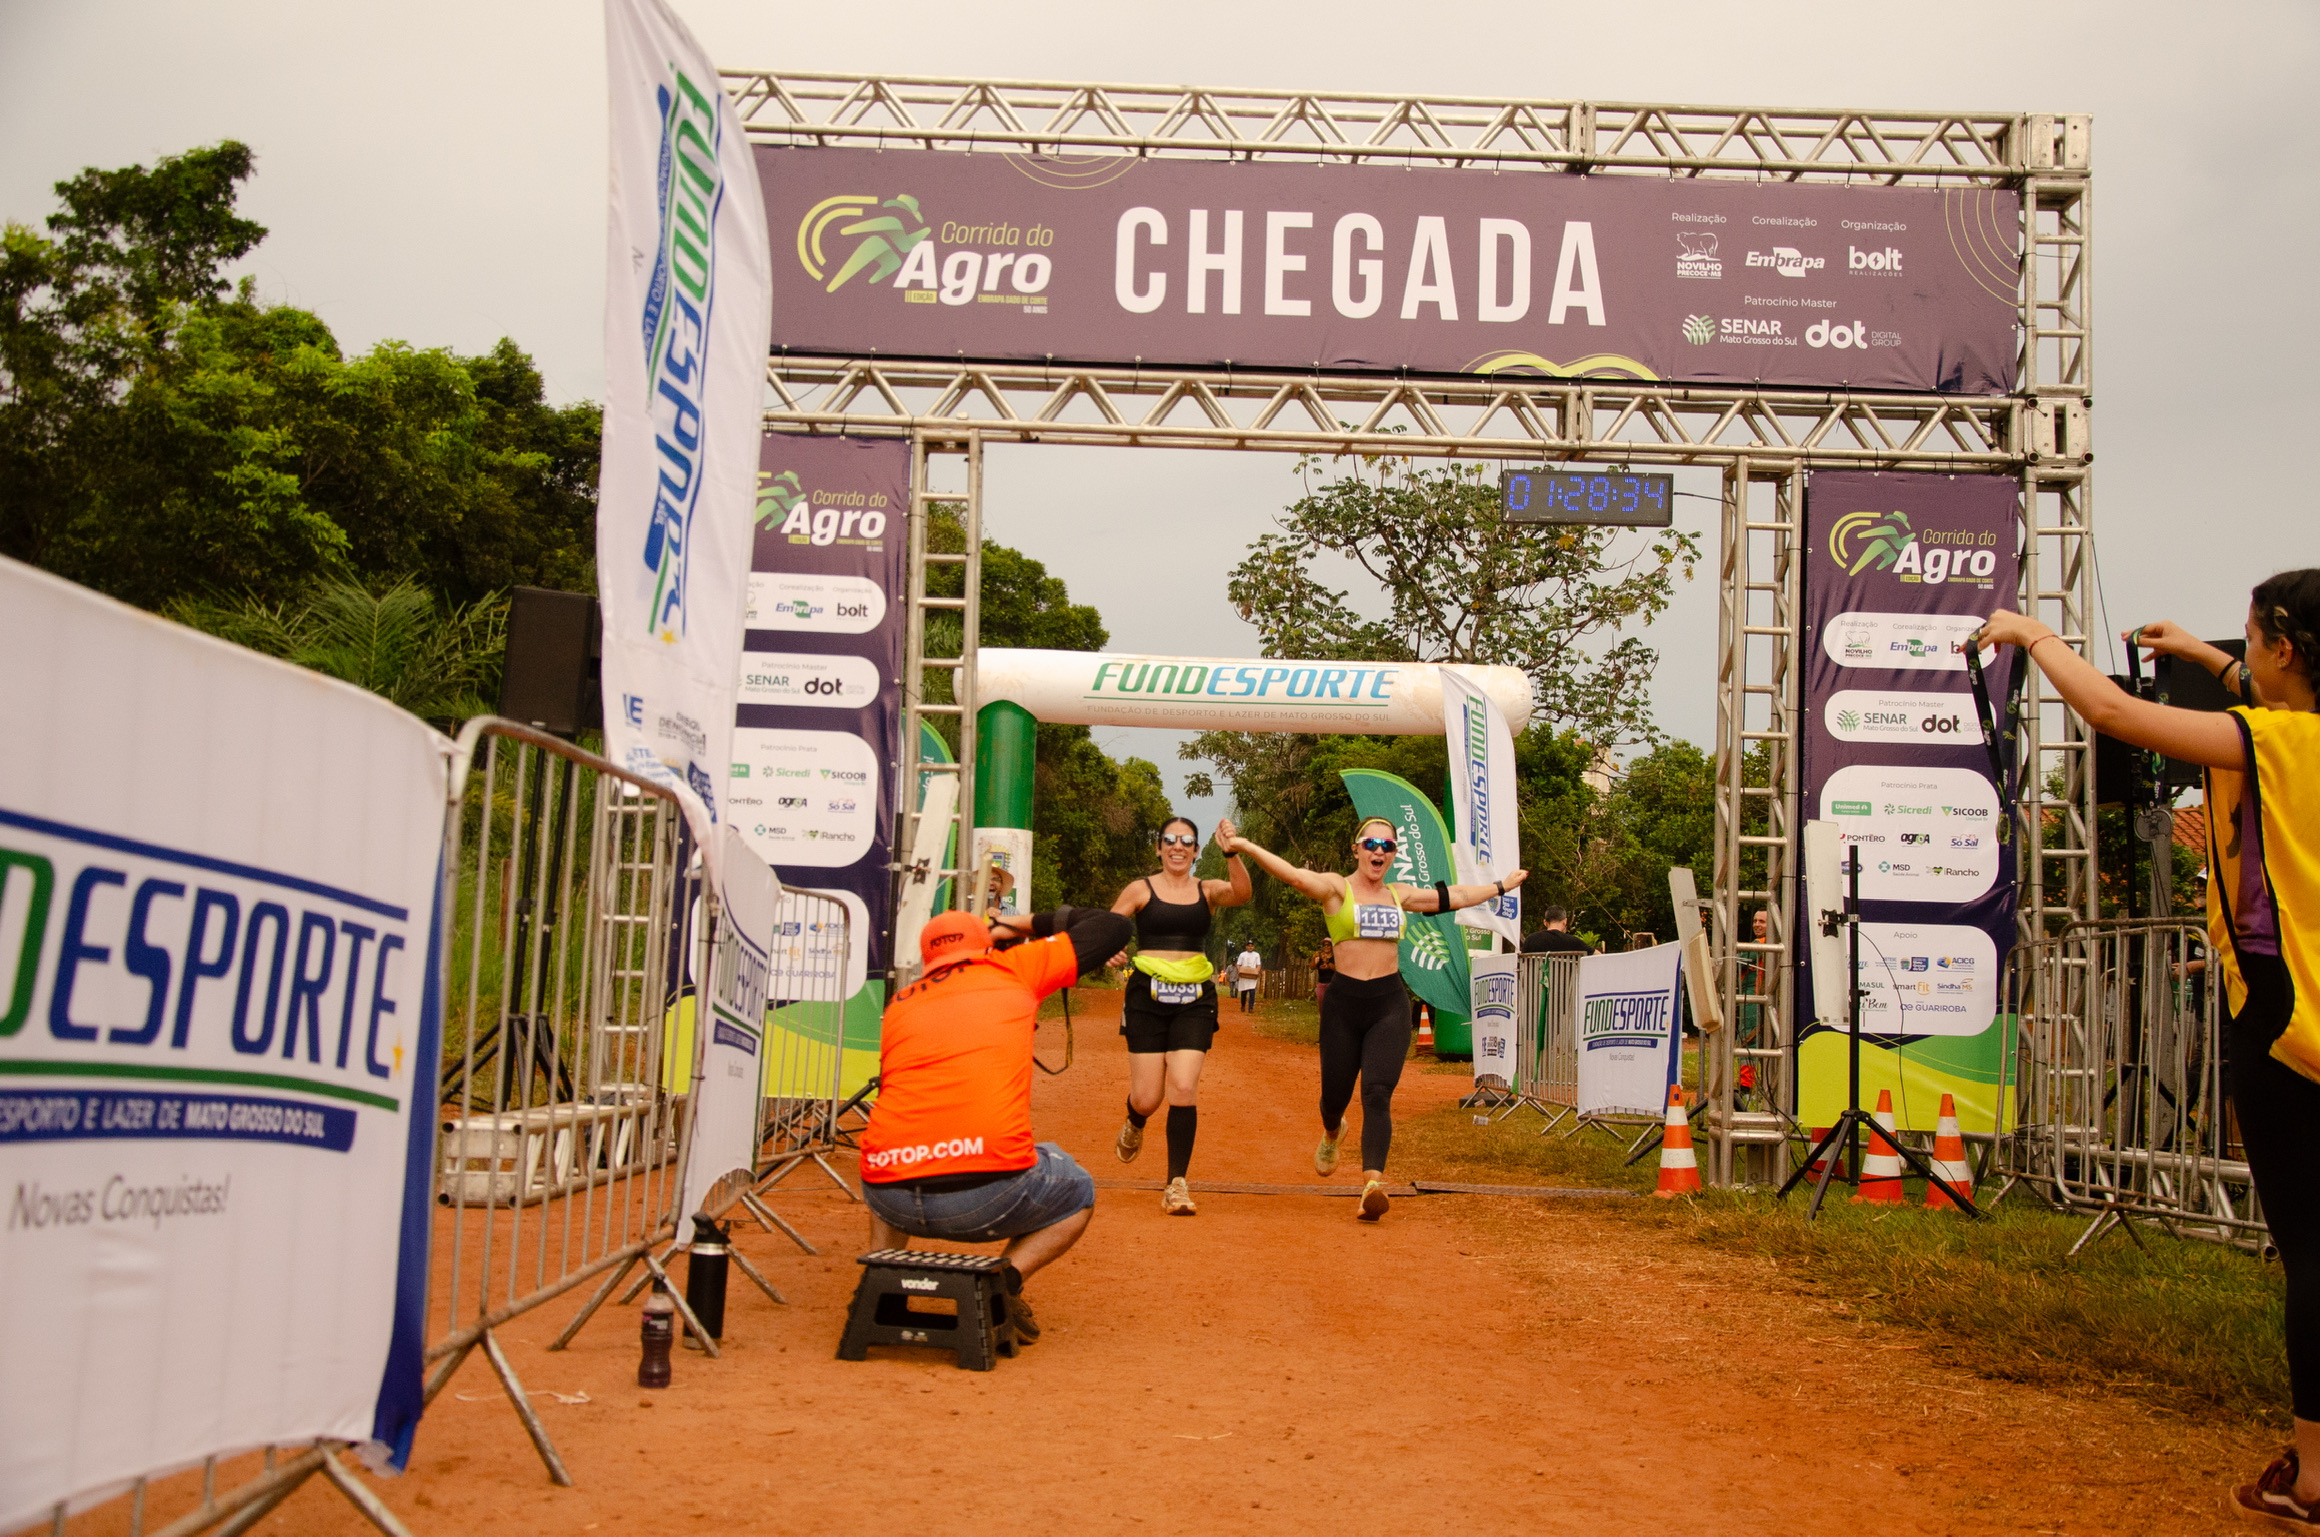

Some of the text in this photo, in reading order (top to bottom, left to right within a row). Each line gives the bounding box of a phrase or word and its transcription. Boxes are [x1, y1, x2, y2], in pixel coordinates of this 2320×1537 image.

[1671, 212, 1727, 225] Realização
[1752, 216, 1818, 228] Corealização
[1841, 219, 1907, 232] Organização
[941, 221, 1055, 248] Corrida do
[1745, 249, 1826, 272] Embrapa
[1849, 245, 1903, 271] bolt
[893, 239, 1053, 306] Agro
[1115, 206, 1606, 326] CHEGADA
[1676, 262, 1723, 271] NOVILHO
[1744, 295, 1837, 308] Patrocínio Master
[1720, 318, 1782, 335] SENAR
[1720, 335, 1798, 346] Mato Grosso do Sul
[1805, 319, 1869, 349] dot
[1871, 331, 1902, 340] DIGITAL
[1871, 339, 1902, 347] GROUP
[812, 489, 888, 508] Corrida do
[1508, 474, 1665, 512] 01:28:34
[780, 501, 887, 546] Agro
[1923, 528, 1996, 545] Corrida do
[1892, 541, 1996, 584] Agro
[778, 583, 824, 592] Corealização
[836, 602, 869, 618] bolt
[1840, 620, 1878, 629] Realização
[1892, 623, 1938, 632] Corealização
[1890, 640, 1938, 654] Embrapa
[761, 661, 828, 671] Patrocínio Master
[745, 674, 790, 686] SENAR
[804, 677, 843, 695] dot
[1091, 661, 1400, 700] FUNDESPORTE
[1878, 699, 1944, 709] Patrocínio Master
[1086, 705, 1141, 715] FUNDAÇÃO
[1162, 709, 1217, 717] DESPORTO
[1228, 710, 1260, 718] LAZER
[1263, 711, 1277, 719] DE
[1279, 712, 1308, 720] MATO
[1310, 712, 1352, 721] GROSSO
[1355, 713, 1370, 721] DO
[1373, 713, 1391, 722] SUL
[1864, 712, 1907, 724] SENAR
[1863, 724, 1879, 732] Mato
[1900, 725, 1909, 733] do
[1921, 714, 1962, 734] dot
[760, 743, 818, 753] Patrocínio Prata
[776, 767, 811, 778] Sicredi
[831, 771, 867, 781] SICOOB
[1881, 781, 1938, 790] Patrocínio Prata
[1897, 805, 1932, 815] Sicredi
[1952, 807, 1989, 817] SICOOB
[1400, 804, 1430, 881] Grosso do Sul
[1361, 911, 1399, 928] 1113
[1893, 931, 1918, 939] Apoio
[1951, 957, 1975, 965] ACICG
[1915, 1004, 1967, 1012] GUARIROBA
[1583, 996, 1669, 1035] FUNDESPORTE
[83, 1097, 326, 1138] E LAZER DE MATO GROSSO DO SUL
[8, 1171, 232, 1232] Novas Conquistas!
[901, 1278, 939, 1291] vonder
